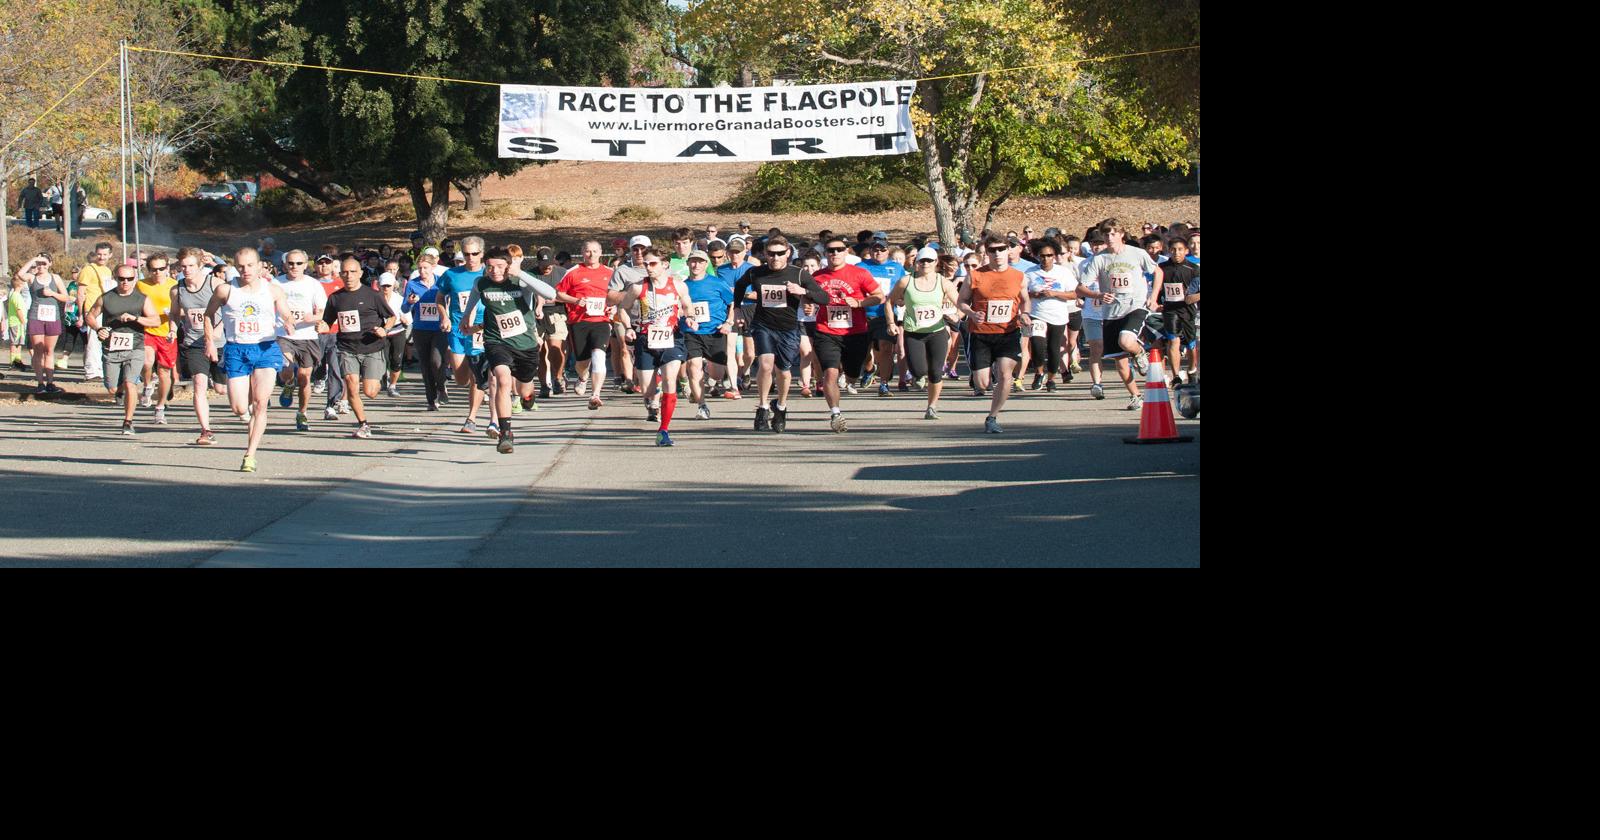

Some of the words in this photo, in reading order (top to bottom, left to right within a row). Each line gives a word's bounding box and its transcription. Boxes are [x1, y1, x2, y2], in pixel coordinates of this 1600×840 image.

[558, 92, 636, 113] RACE
[646, 93, 685, 114] TO
[694, 93, 753, 113] THE
[763, 86, 912, 112] FLAGPOLE
[588, 115, 885, 131] www.LivermoreGranadaBoosters.org
[507, 132, 906, 158] START
[1112, 277, 1129, 287] 716
[764, 289, 783, 300] 769
[1166, 286, 1181, 296] 718
[421, 306, 437, 315] 740
[694, 306, 705, 316] 61
[830, 310, 849, 321] 765
[917, 310, 935, 321] 723
[991, 305, 1010, 316] 767
[191, 313, 204, 323] 78
[340, 315, 357, 326] 735
[500, 316, 521, 330] 698
[651, 330, 670, 341] 779
[113, 336, 130, 347] 772
